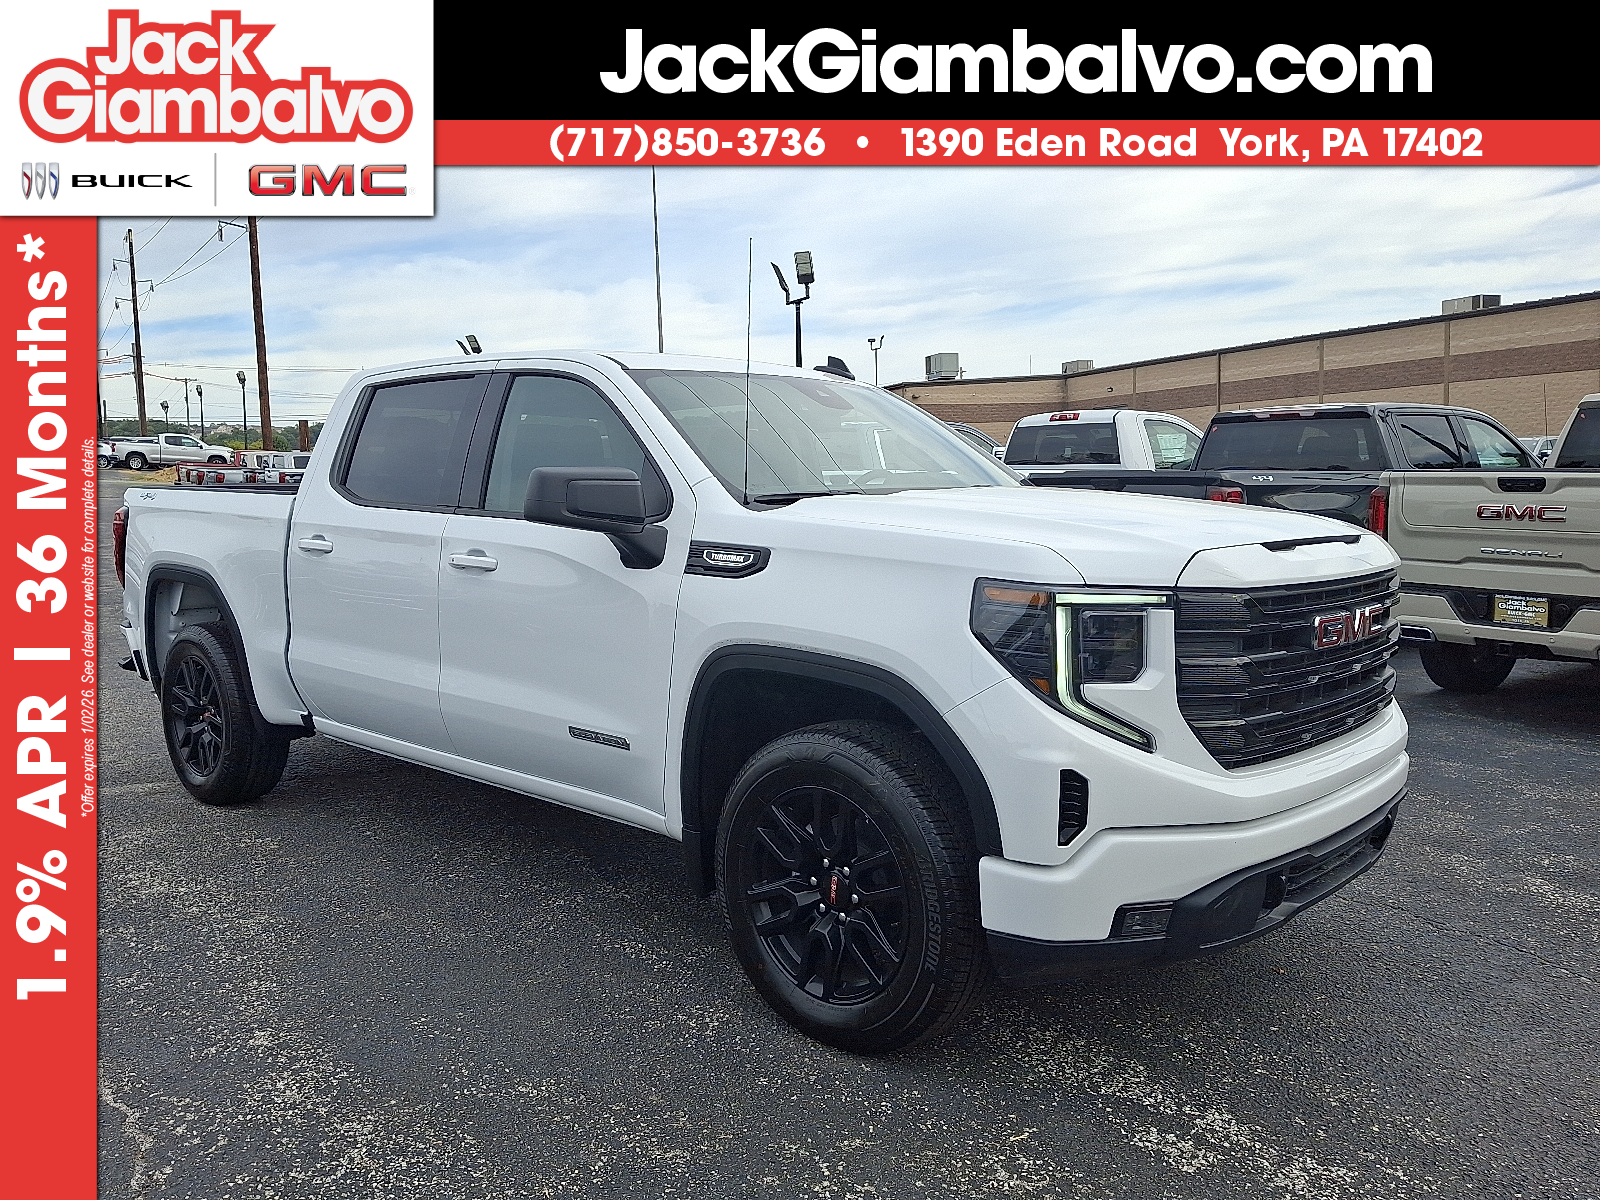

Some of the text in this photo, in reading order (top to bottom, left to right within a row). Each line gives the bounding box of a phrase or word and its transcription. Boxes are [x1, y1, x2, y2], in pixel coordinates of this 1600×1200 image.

[1477, 504, 1567, 522] GMC
[1480, 546, 1563, 559] DENALI
[1506, 599, 1527, 607] Jack
[1312, 604, 1384, 650] GMC
